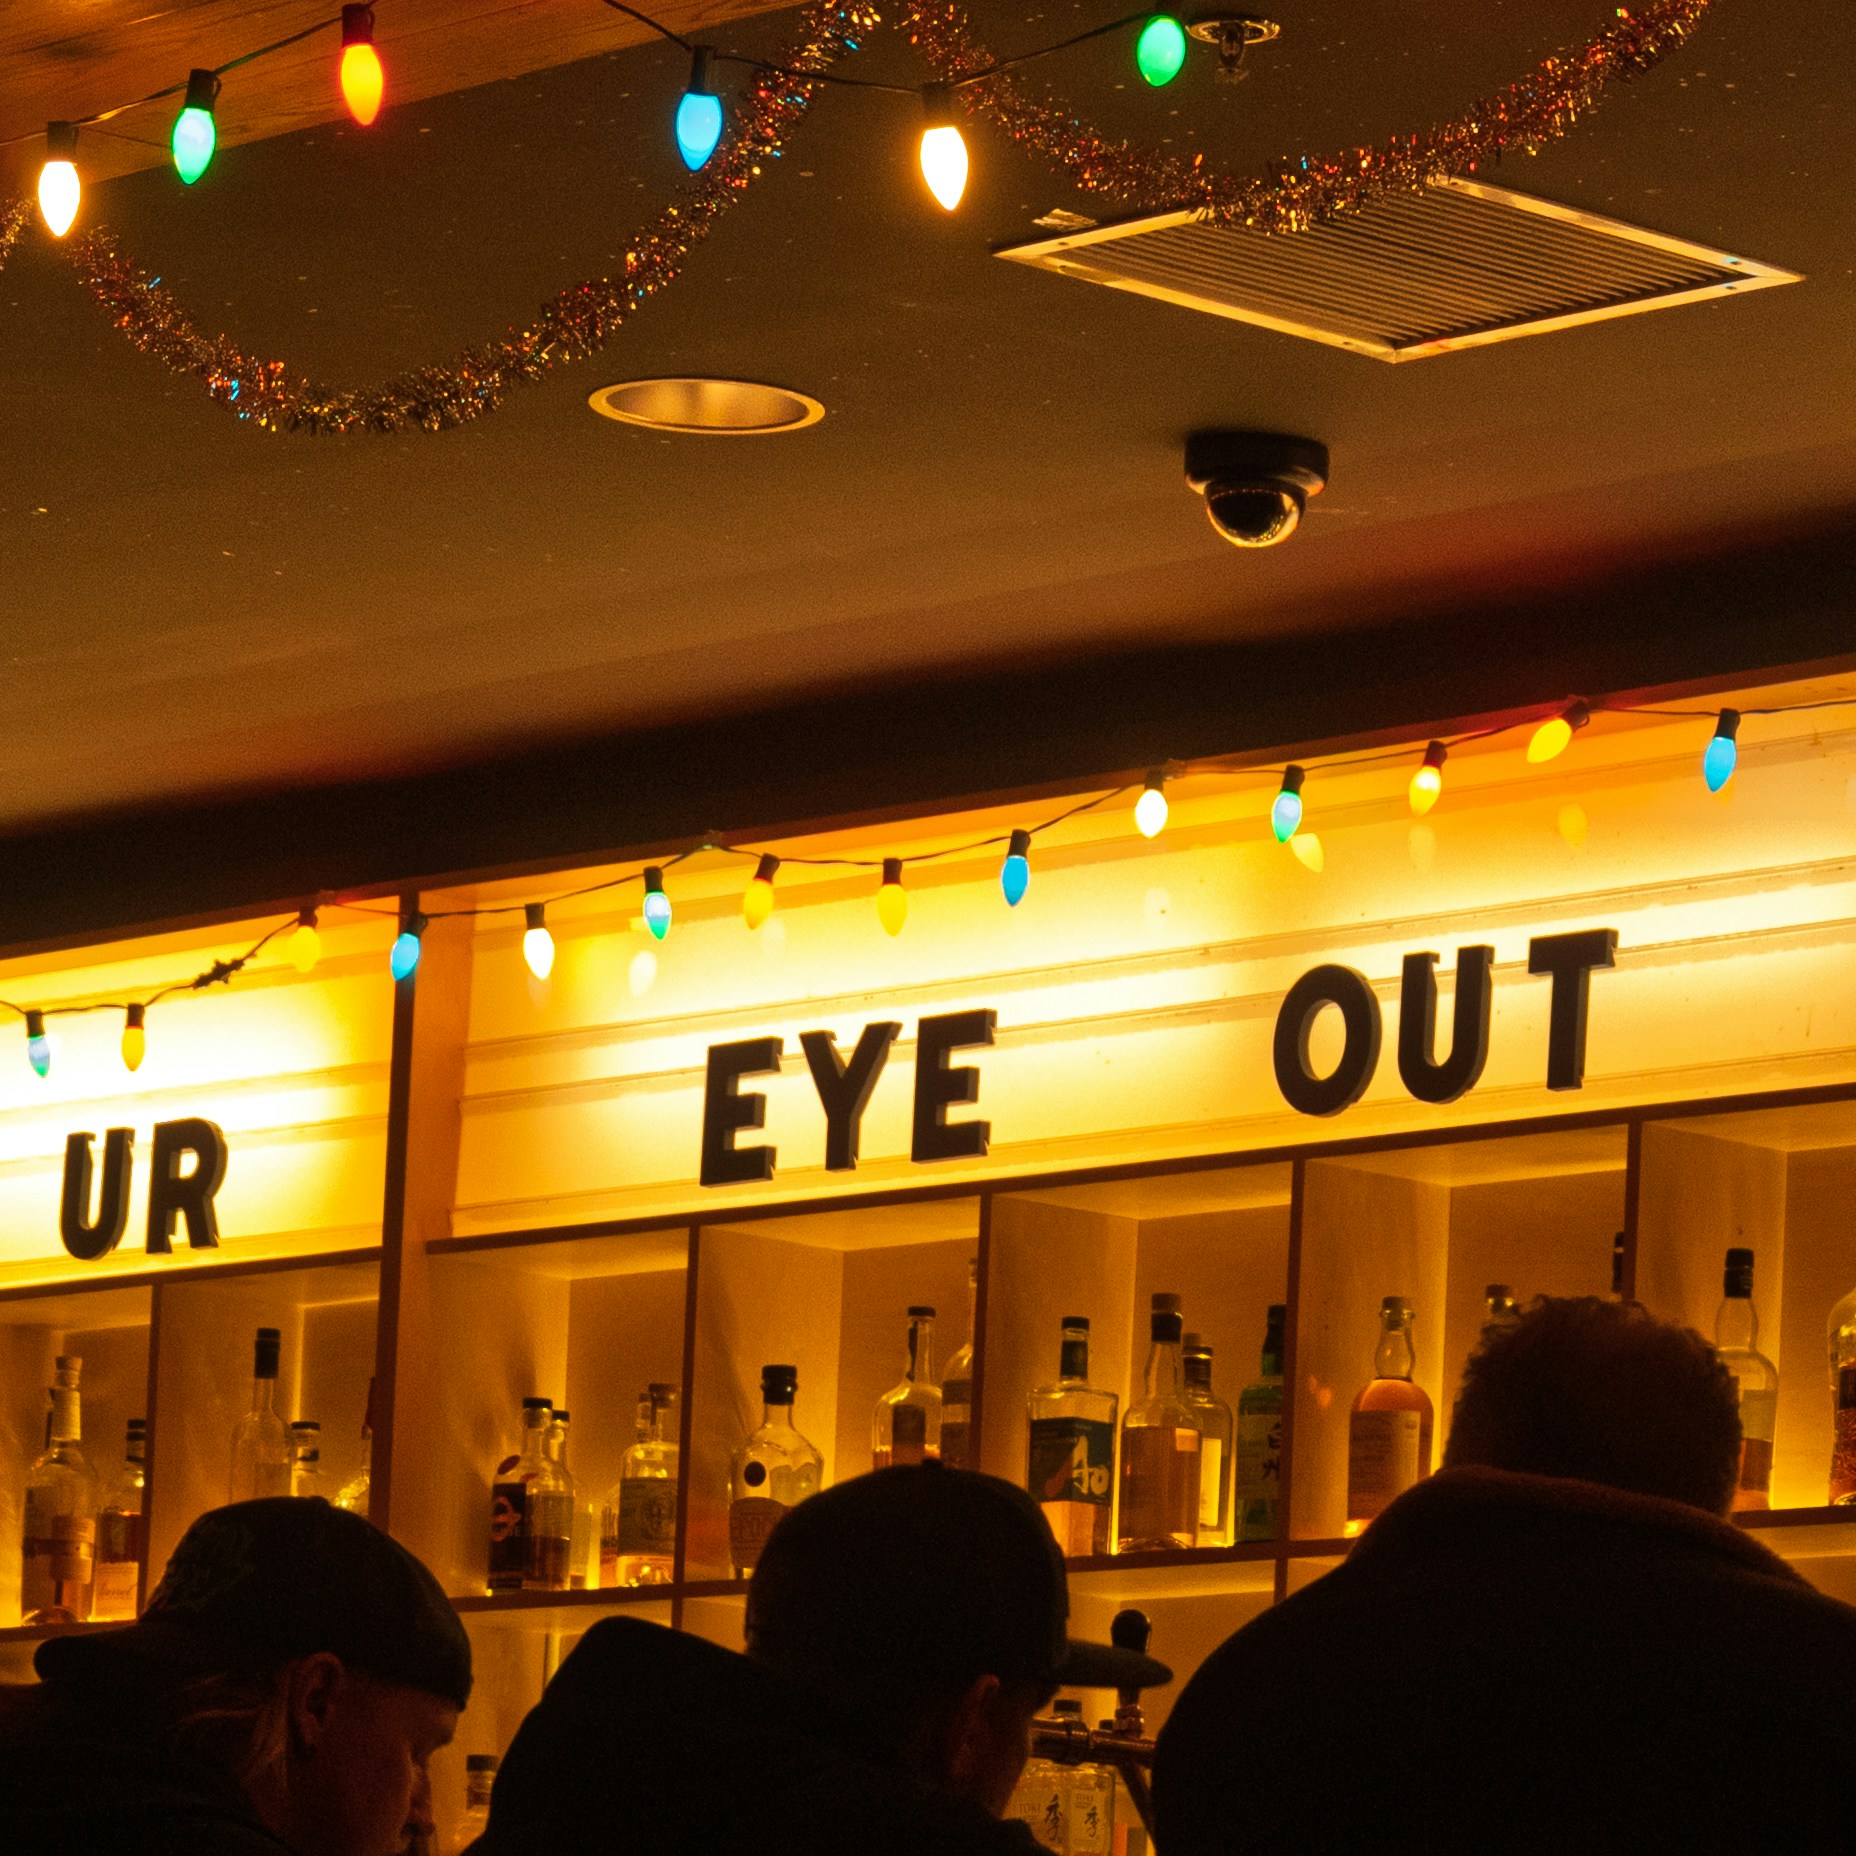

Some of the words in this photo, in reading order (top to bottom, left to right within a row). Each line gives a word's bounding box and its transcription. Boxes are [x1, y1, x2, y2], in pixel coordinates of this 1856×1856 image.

[699, 1008, 999, 1189] EYE
[1272, 927, 1620, 1118] OUT
[58, 1116, 229, 1262] UR
